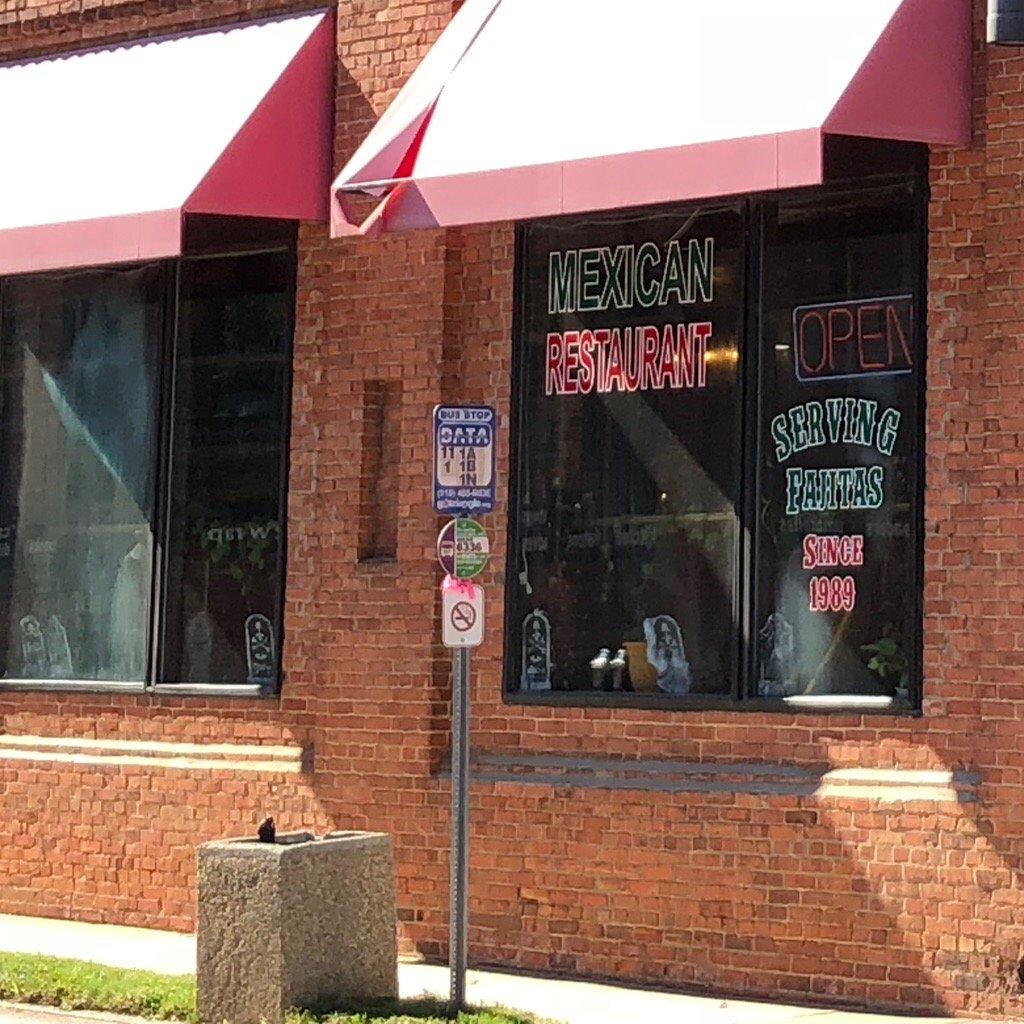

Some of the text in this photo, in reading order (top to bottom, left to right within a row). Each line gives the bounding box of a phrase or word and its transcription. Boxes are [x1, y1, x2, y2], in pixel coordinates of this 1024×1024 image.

[548, 237, 714, 314] MEXICAN
[800, 304, 914, 373] OPEN
[545, 321, 712, 395] RESTAURANT
[440, 410, 490, 419] BUS STOP
[771, 398, 901, 463] SERVING
[440, 427, 489, 444] DATA
[441, 446, 476, 460] 11 1A
[444, 461, 450, 473] 1
[458, 473, 477, 486] 1N
[786, 466, 884, 515] FAJITAS
[803, 534, 864, 569] SINCE
[809, 576, 856, 612] 1989
